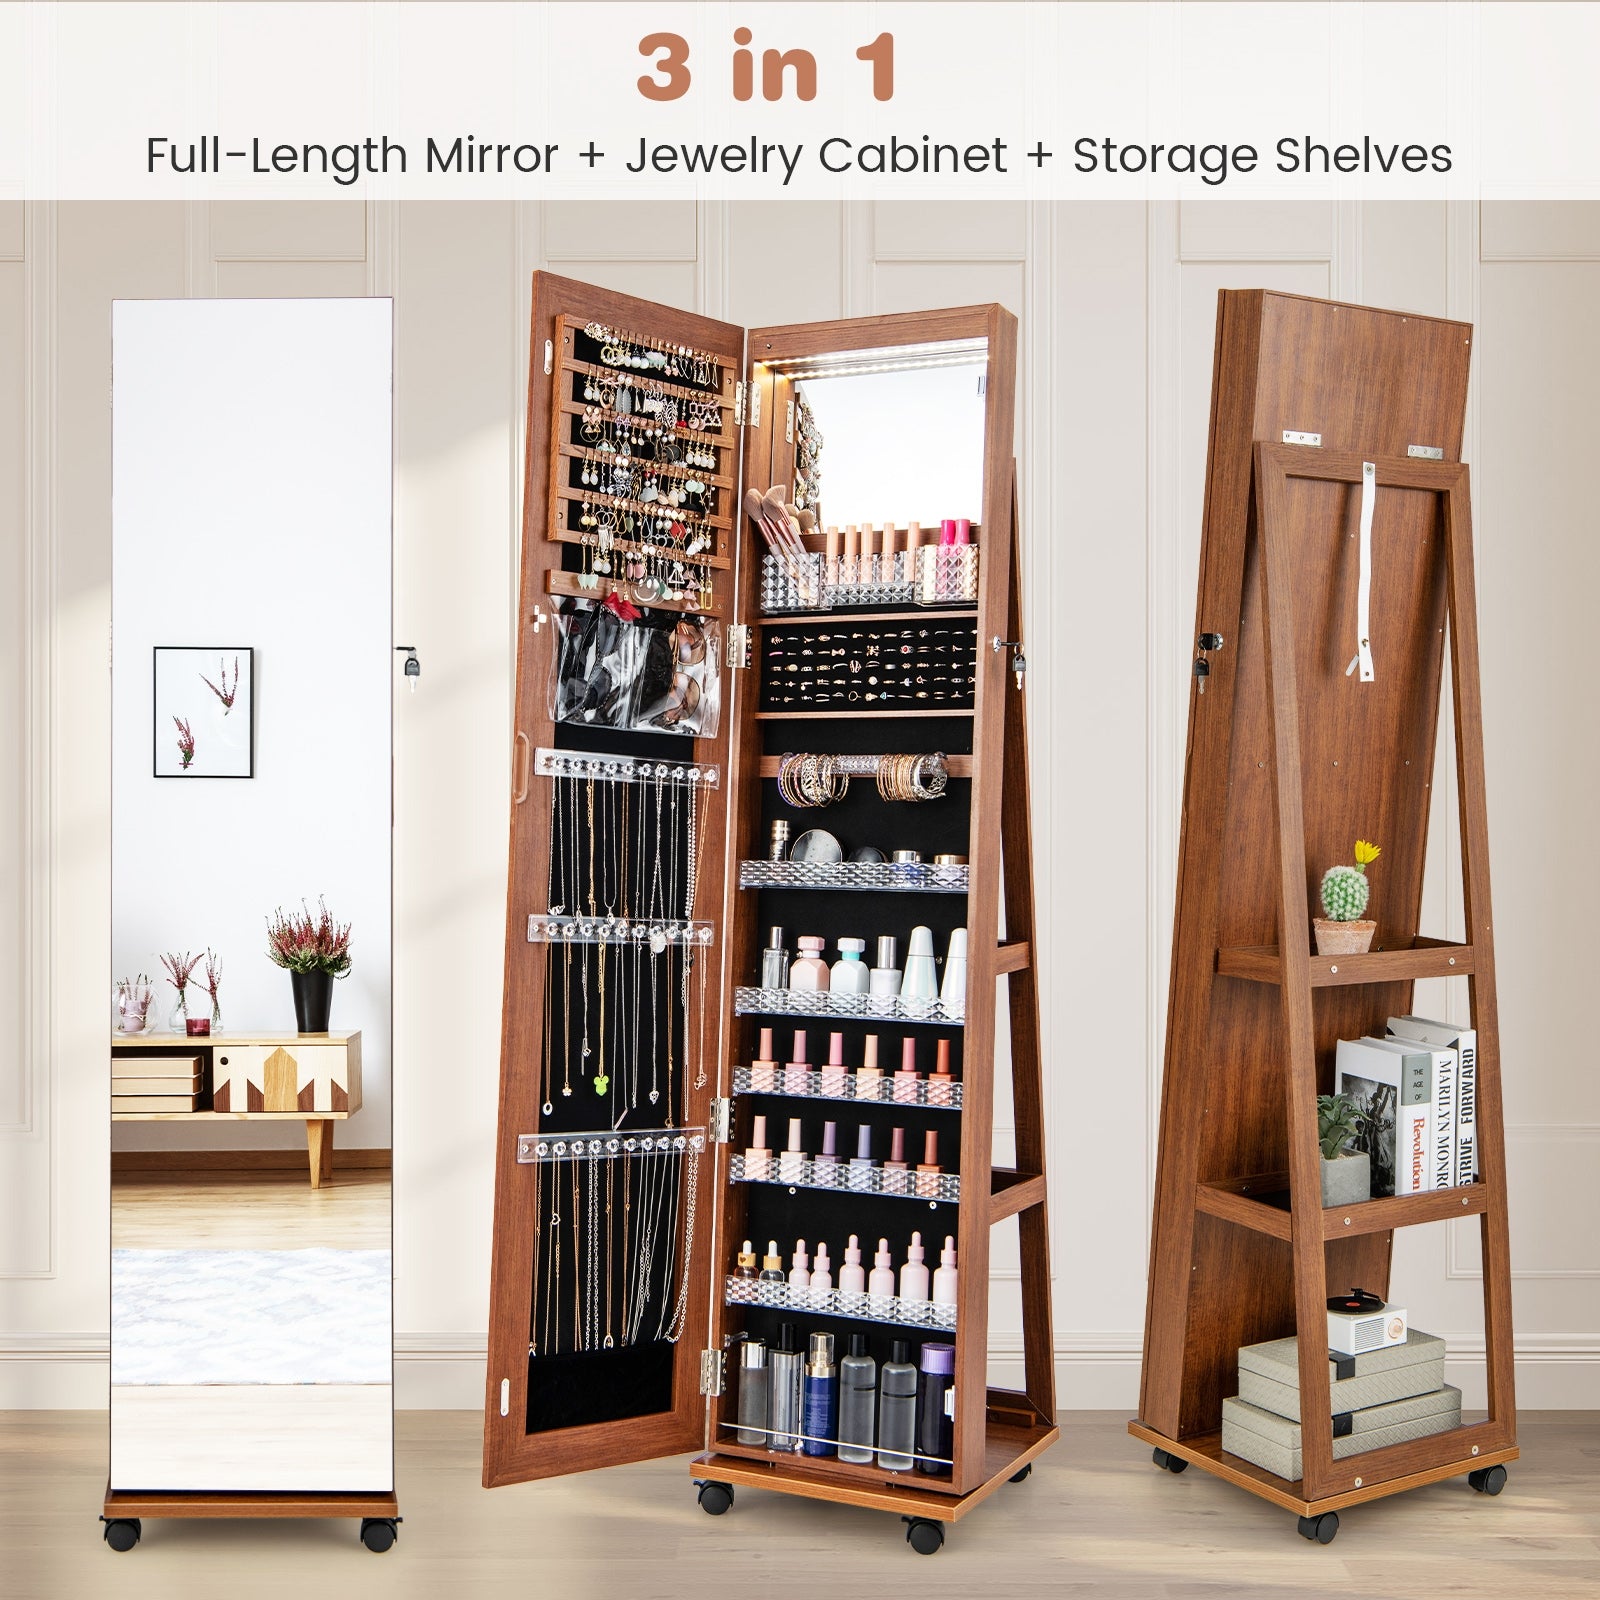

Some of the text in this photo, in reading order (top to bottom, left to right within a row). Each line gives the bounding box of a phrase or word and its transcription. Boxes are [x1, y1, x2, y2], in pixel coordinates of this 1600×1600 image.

[1413, 1080, 1424, 1088] AGE
[1414, 1093, 1423, 1101] OF
[1438, 1060, 1452, 1133] MARILYN
[1461, 1048, 1474, 1125] FORWARD
[1412, 1116, 1425, 1191] Revolution
